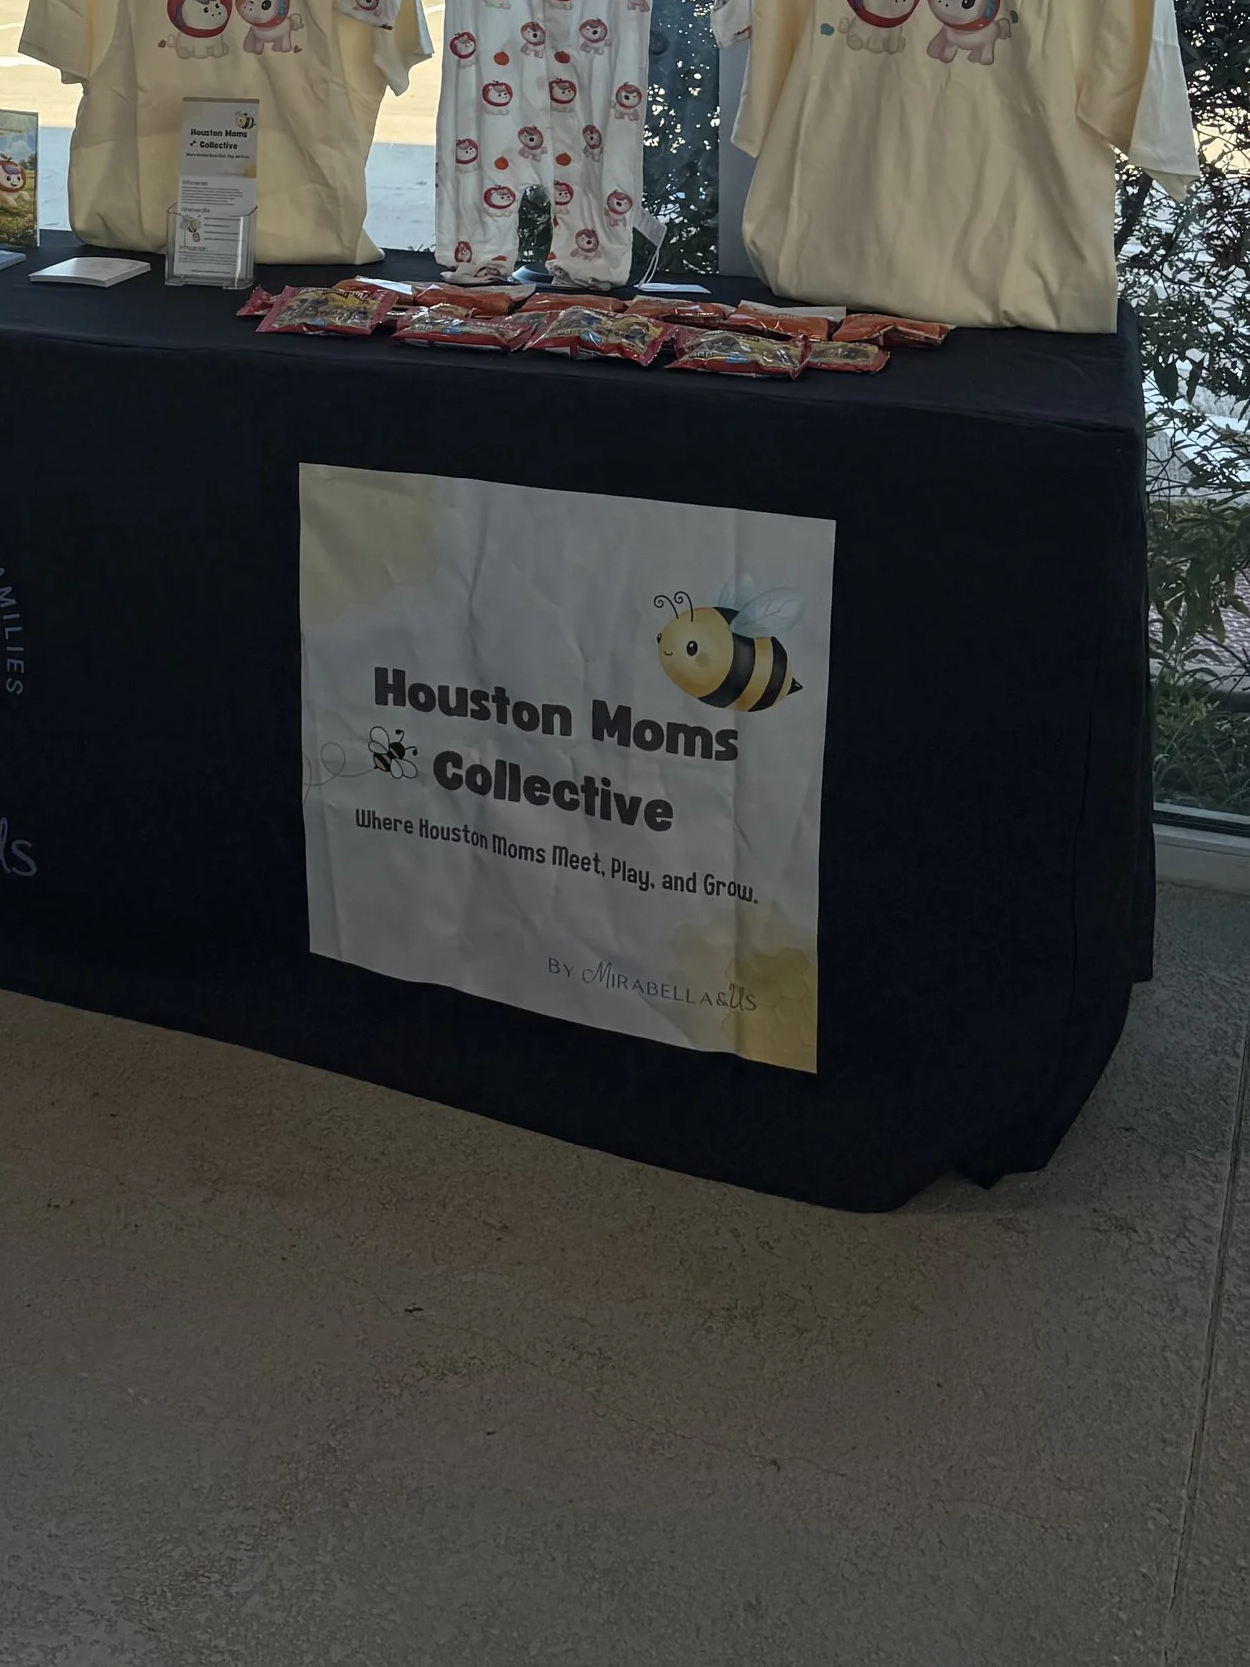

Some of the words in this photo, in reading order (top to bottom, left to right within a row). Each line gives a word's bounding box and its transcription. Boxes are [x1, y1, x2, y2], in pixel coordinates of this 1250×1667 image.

[190, 128, 223, 137] Houston
[225, 130, 248, 138] Moms
[199, 141, 238, 150] Collective
[374, 667, 572, 738] Houston
[591, 699, 739, 762] Moms
[432, 750, 674, 833] Collective
[355, 808, 414, 836] Where
[419, 817, 488, 850] Houston
[492, 833, 546, 864] Moms
[551, 844, 606, 878] Meet,
[611, 860, 655, 891] Play,
[661, 871, 697, 894] and
[703, 873, 759, 905] Grow.
[548, 957, 574, 978] BY
